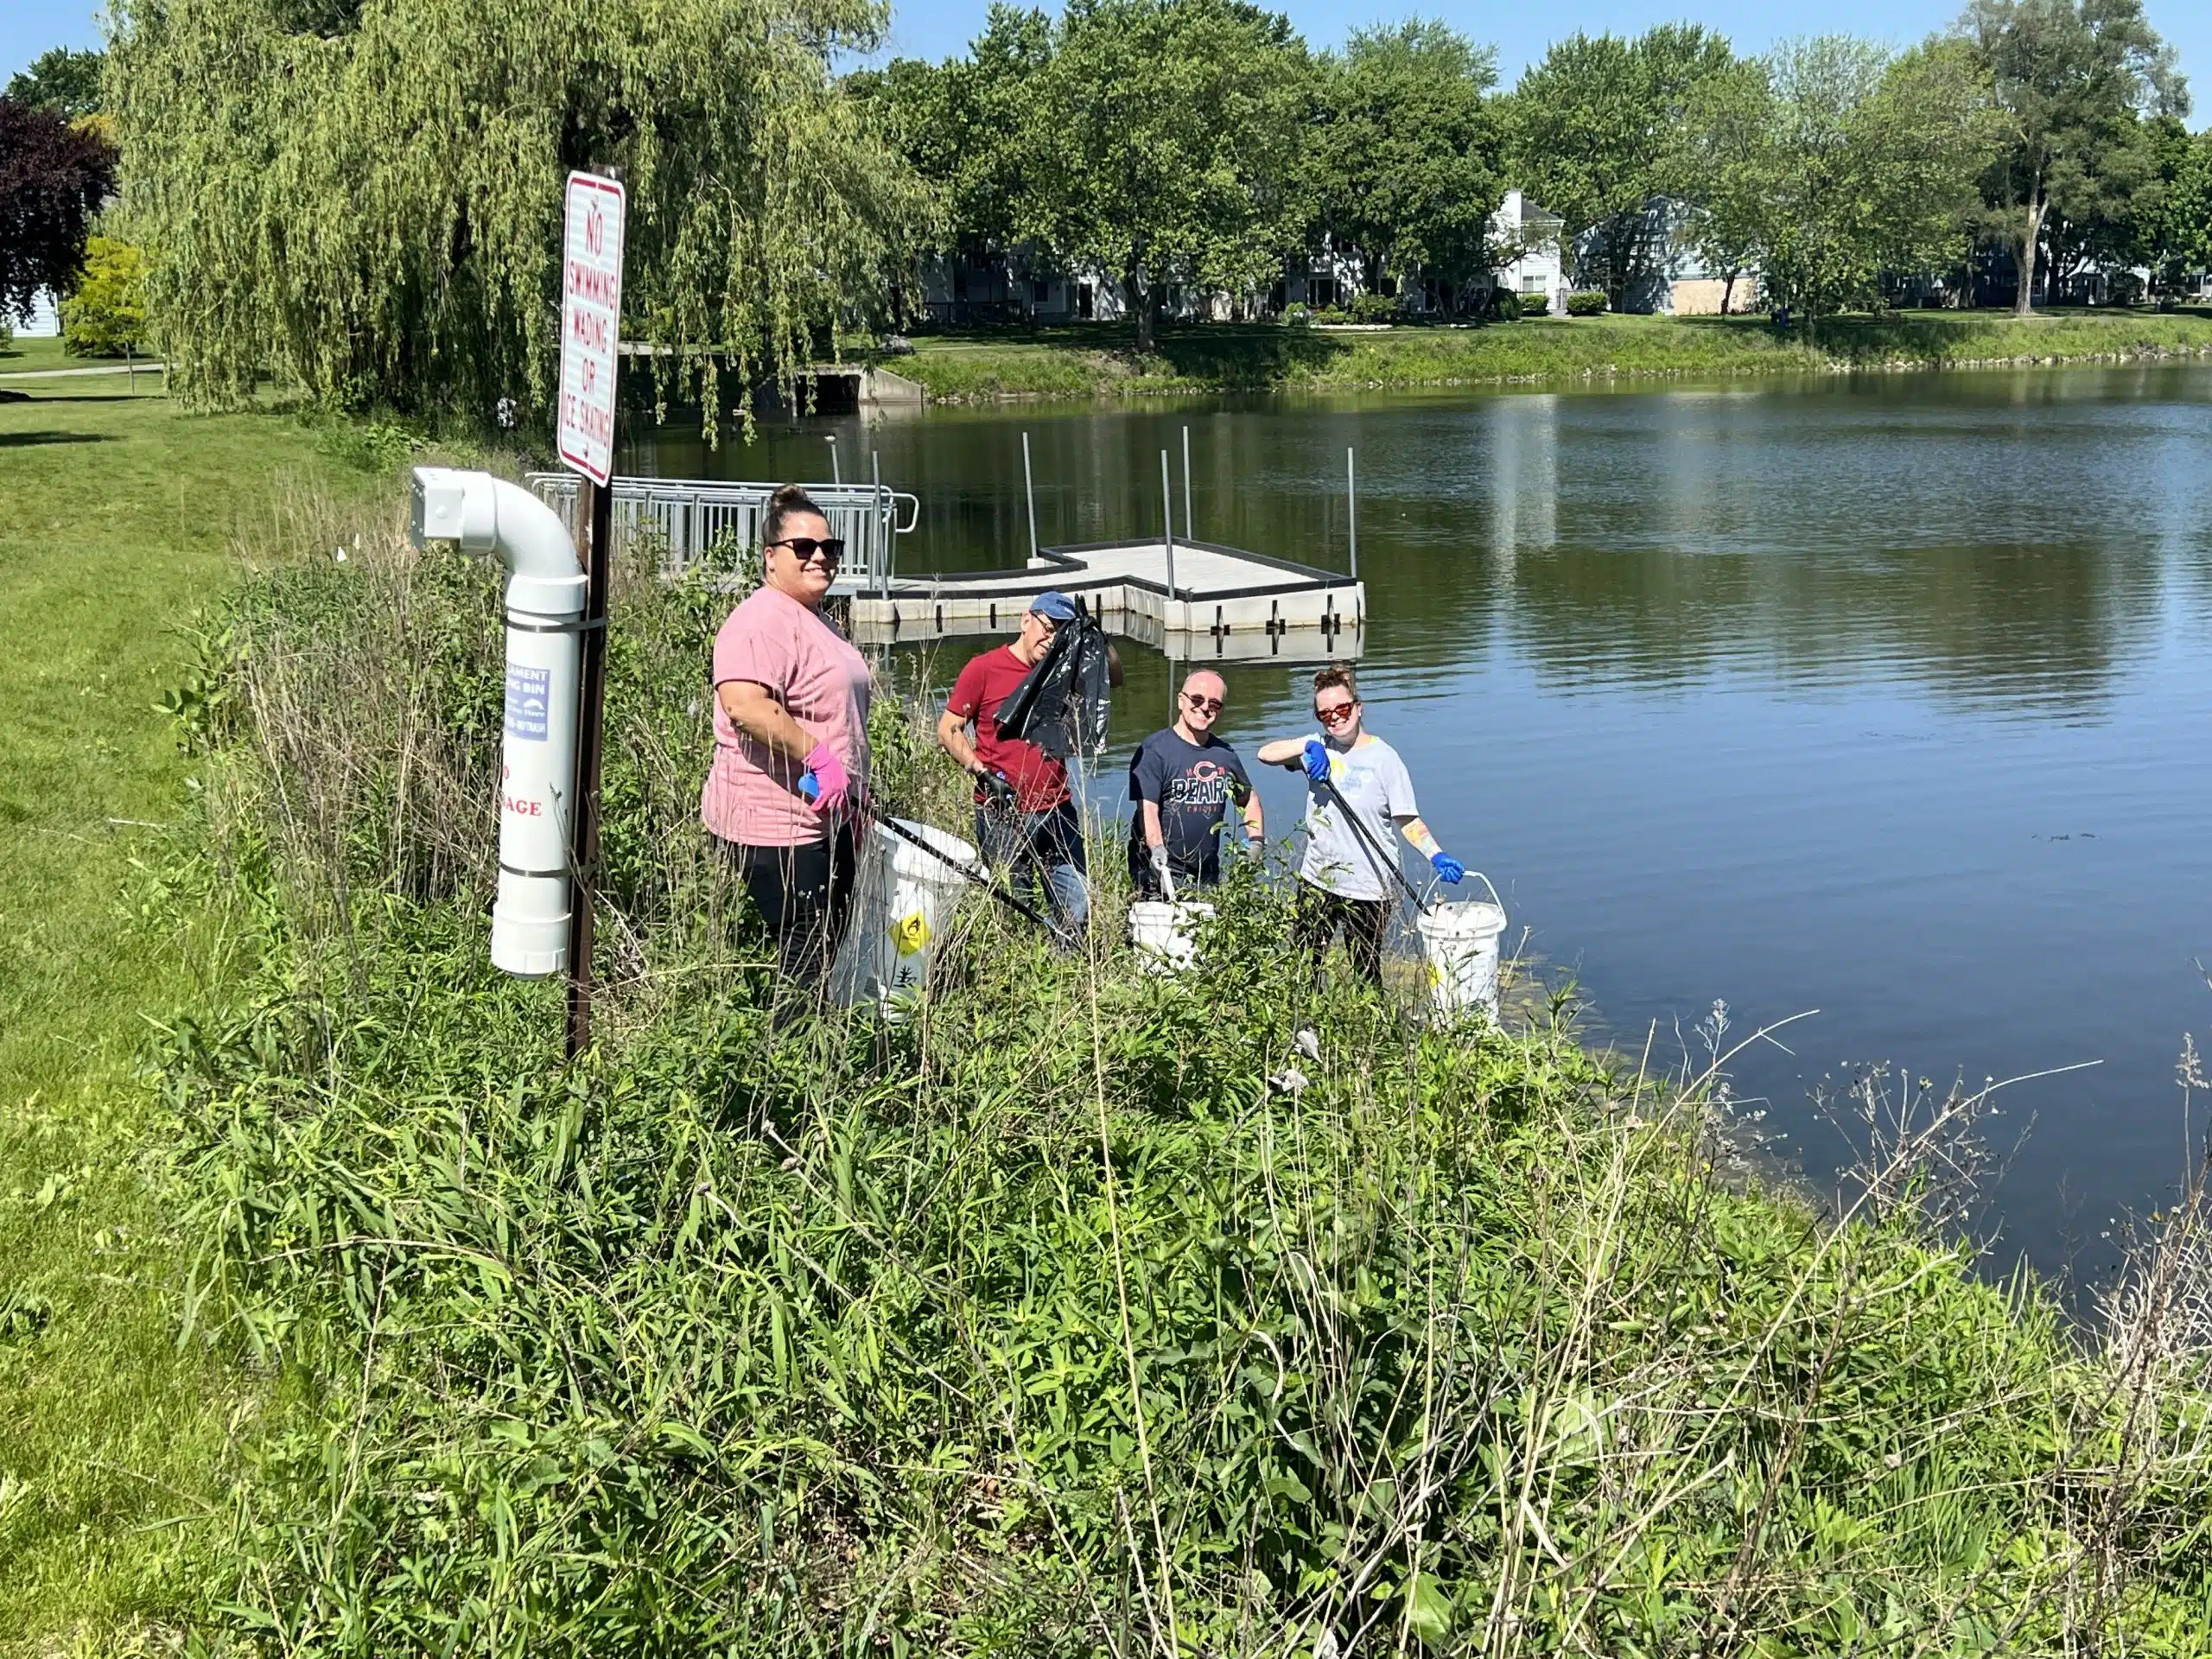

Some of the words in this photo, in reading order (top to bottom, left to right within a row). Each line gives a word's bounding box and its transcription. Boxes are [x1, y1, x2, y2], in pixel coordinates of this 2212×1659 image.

[586, 211, 603, 257] NO
[569, 260, 615, 310] SWIMMING
[574, 308, 607, 354] WADING
[582, 358, 595, 394] OR
[563, 391, 576, 429] ICE
[580, 399, 610, 448] SKATING
